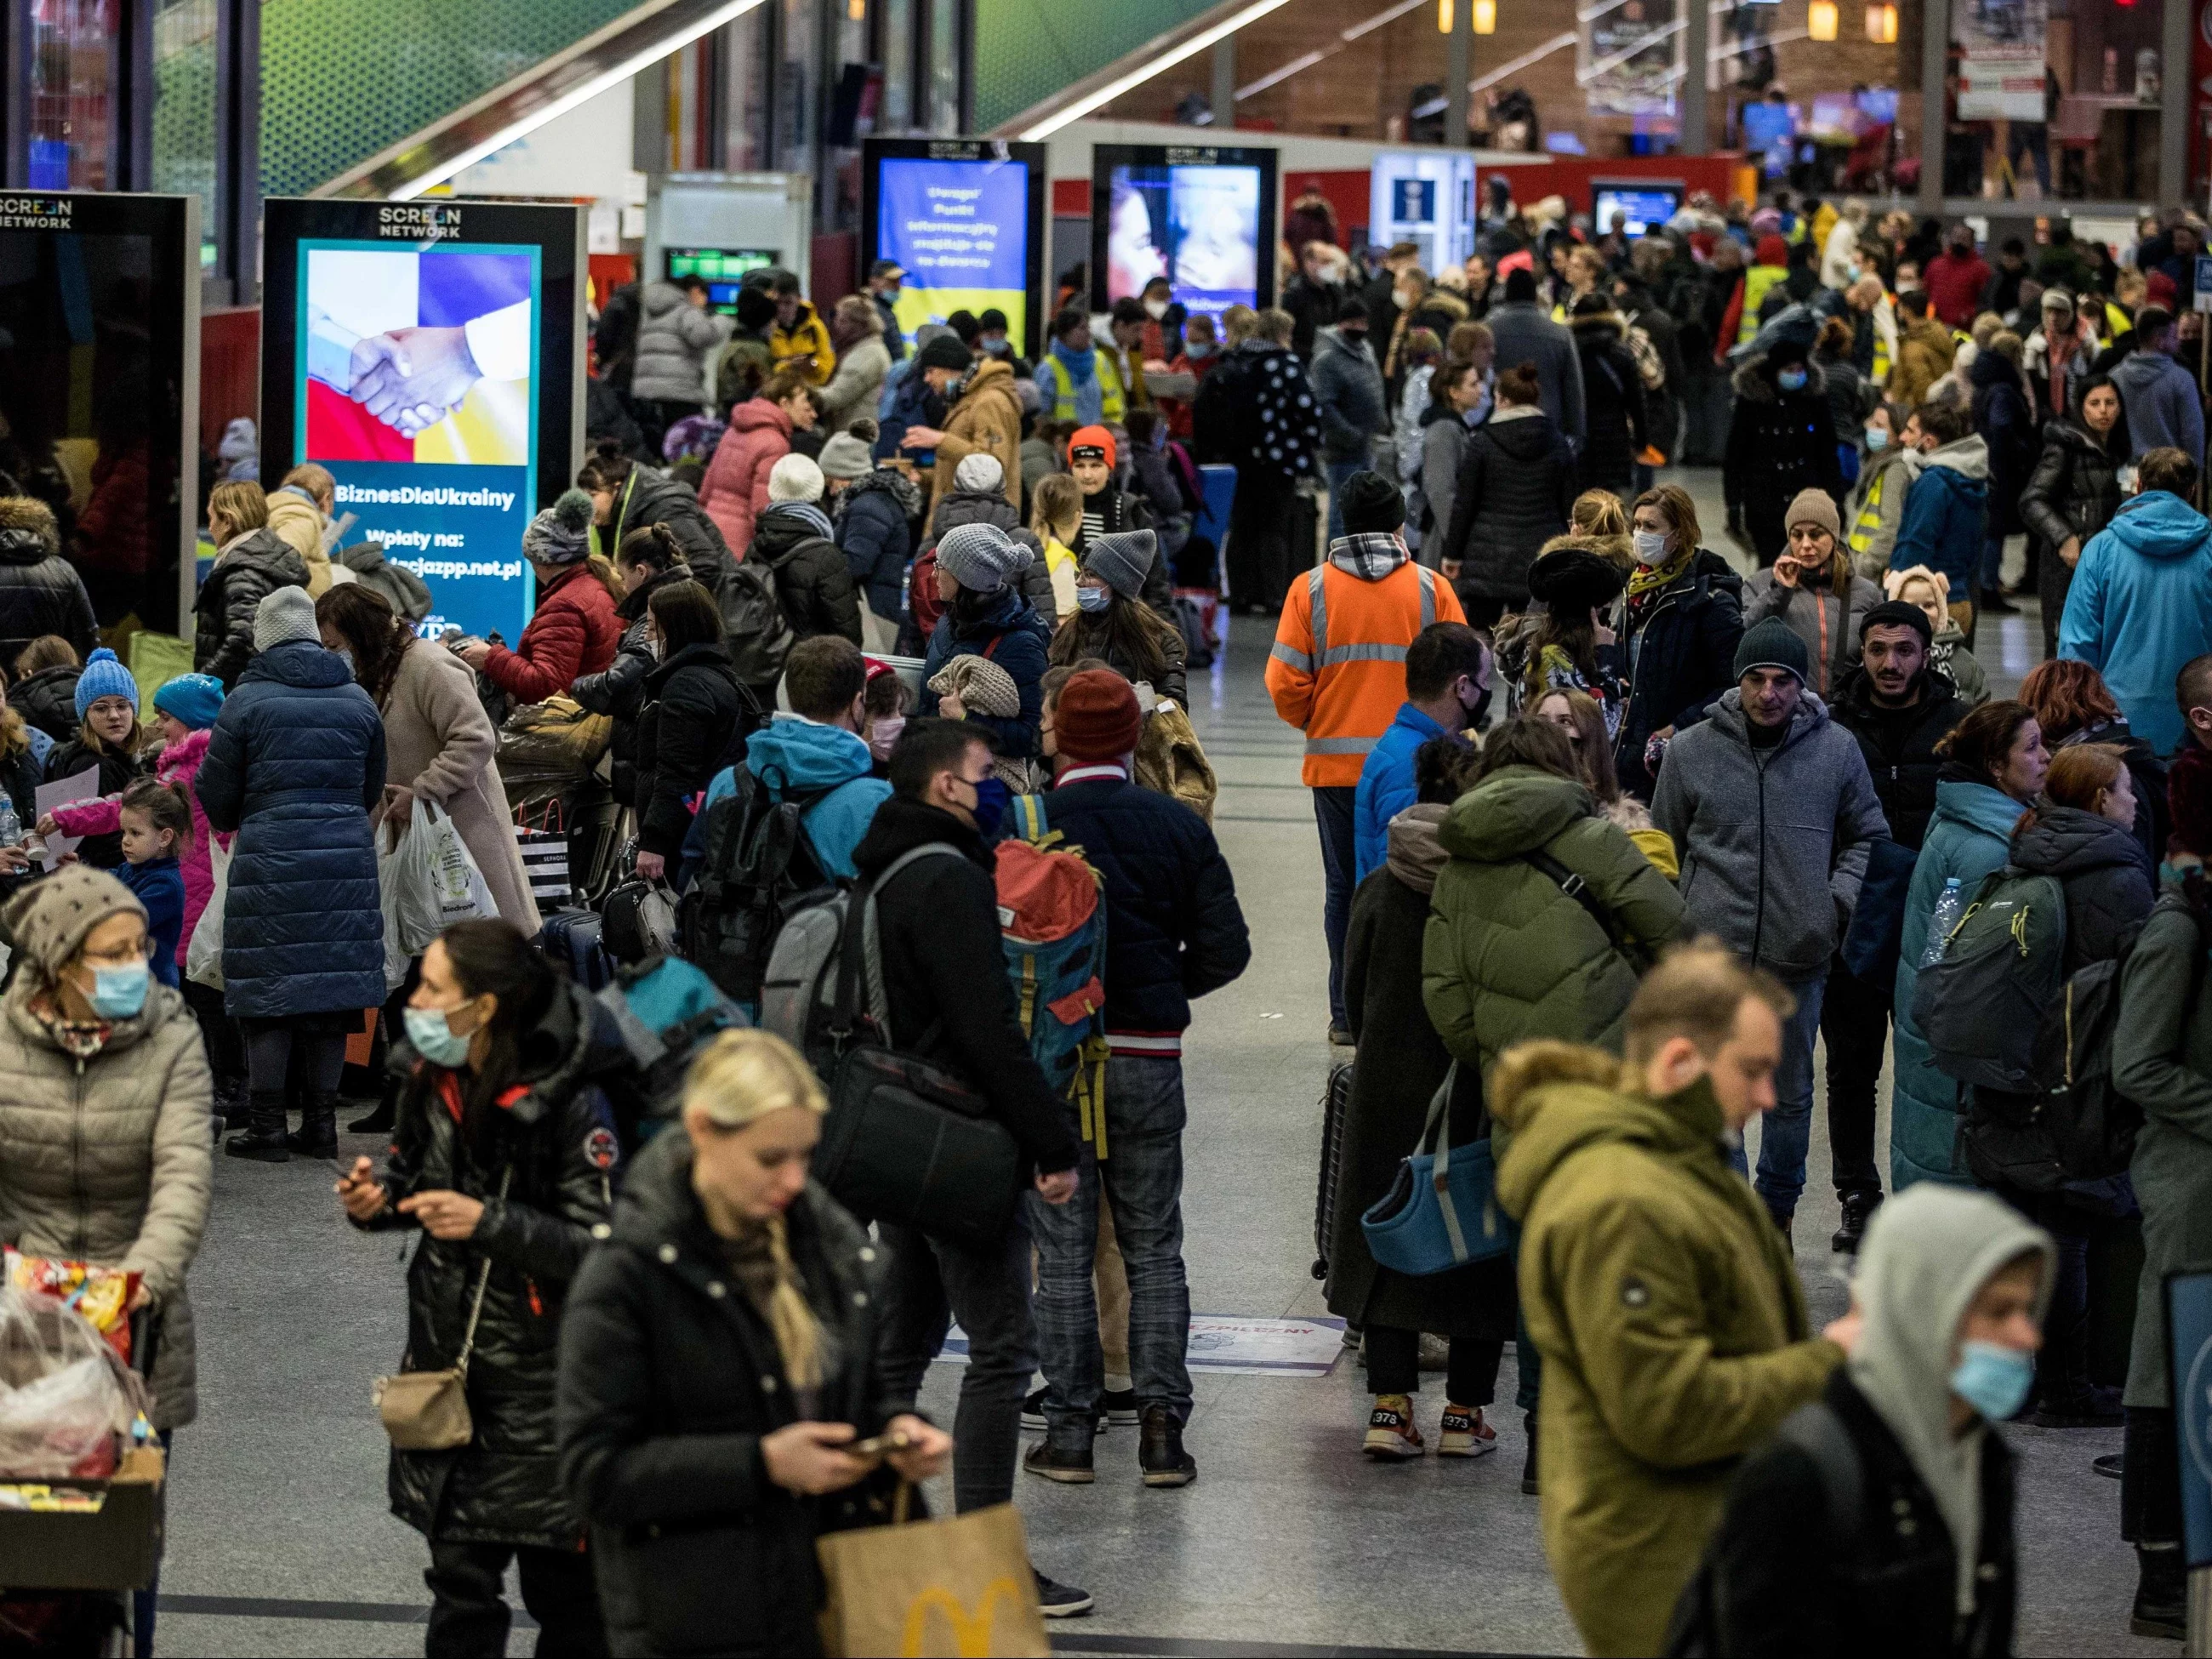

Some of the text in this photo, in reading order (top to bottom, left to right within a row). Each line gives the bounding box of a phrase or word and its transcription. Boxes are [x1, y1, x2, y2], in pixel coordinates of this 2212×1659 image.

[0, 216, 71, 229] ETWORK
[379, 225, 460, 238] NETWORK
[366, 529, 465, 551] Wpłaty na:
